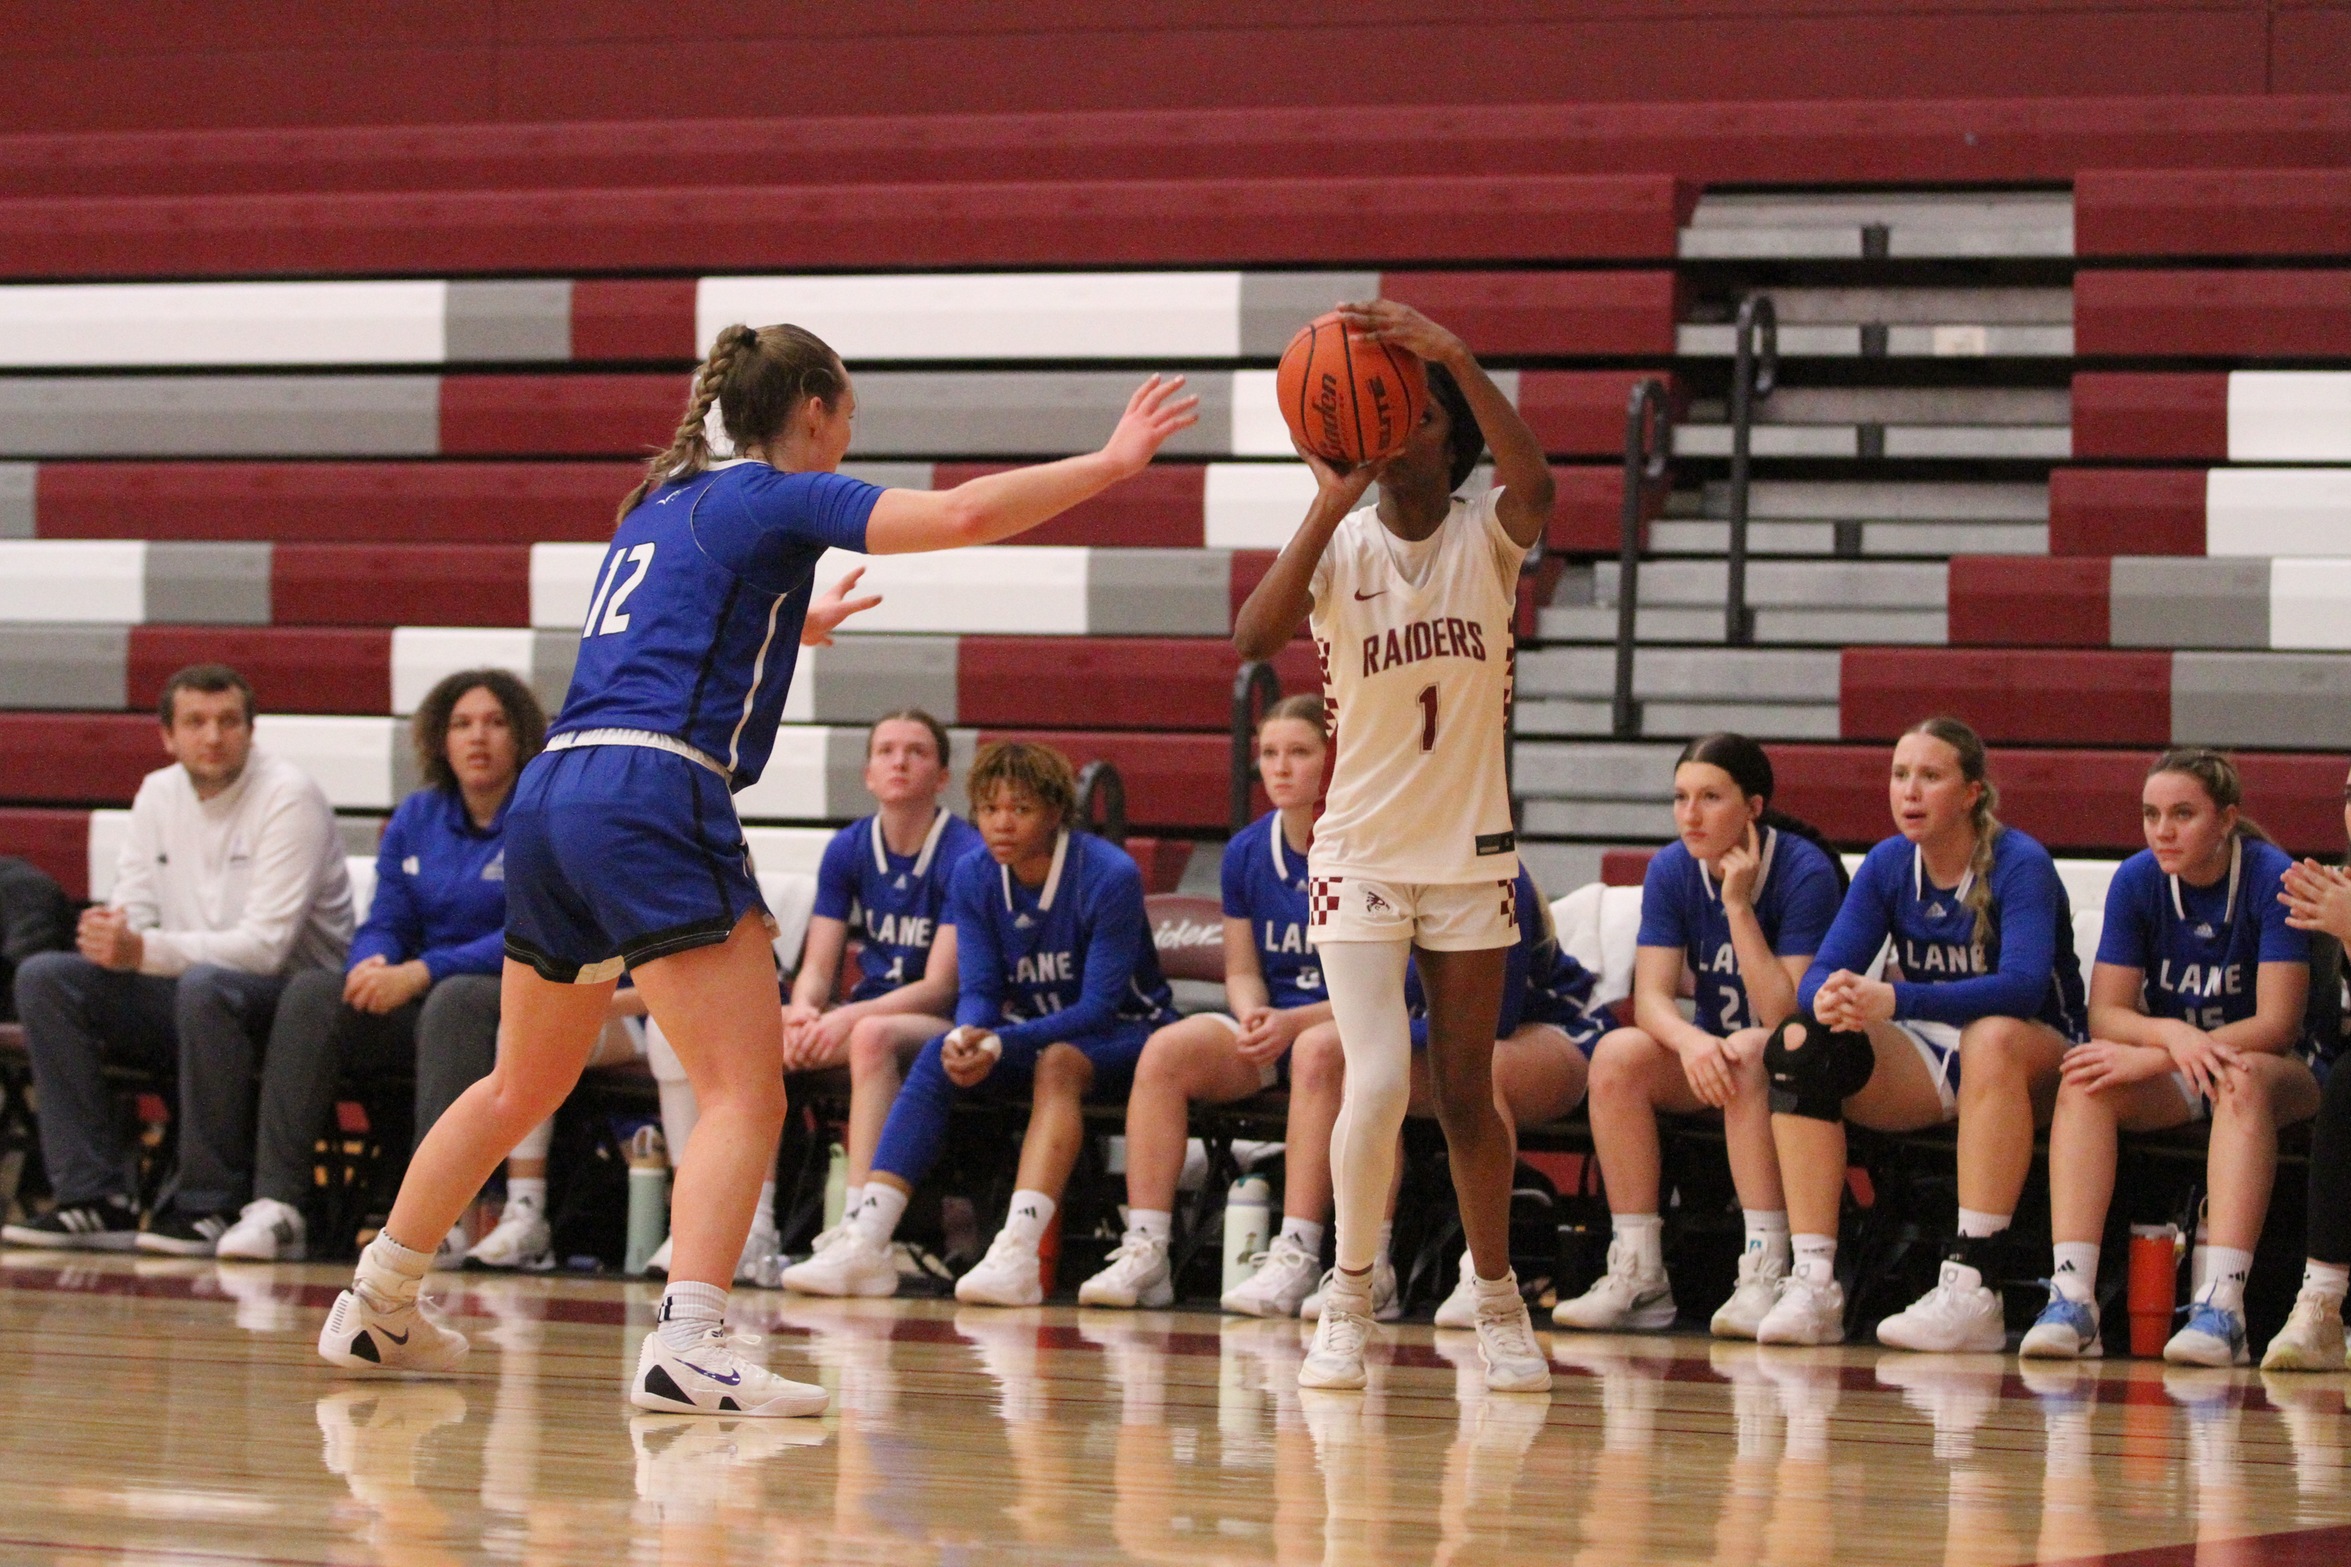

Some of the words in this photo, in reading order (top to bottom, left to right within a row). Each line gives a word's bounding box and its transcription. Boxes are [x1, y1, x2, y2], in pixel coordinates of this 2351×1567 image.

[582, 542, 655, 638] 12
[1363, 617, 1486, 678] RAIDERS
[1416, 681, 1440, 754] 1
[865, 909, 931, 947] LANE
[1007, 951, 1074, 983] ANE
[1699, 940, 1740, 975] LA
[1907, 940, 1988, 972] LANE
[2160, 959, 2242, 997] LANE
